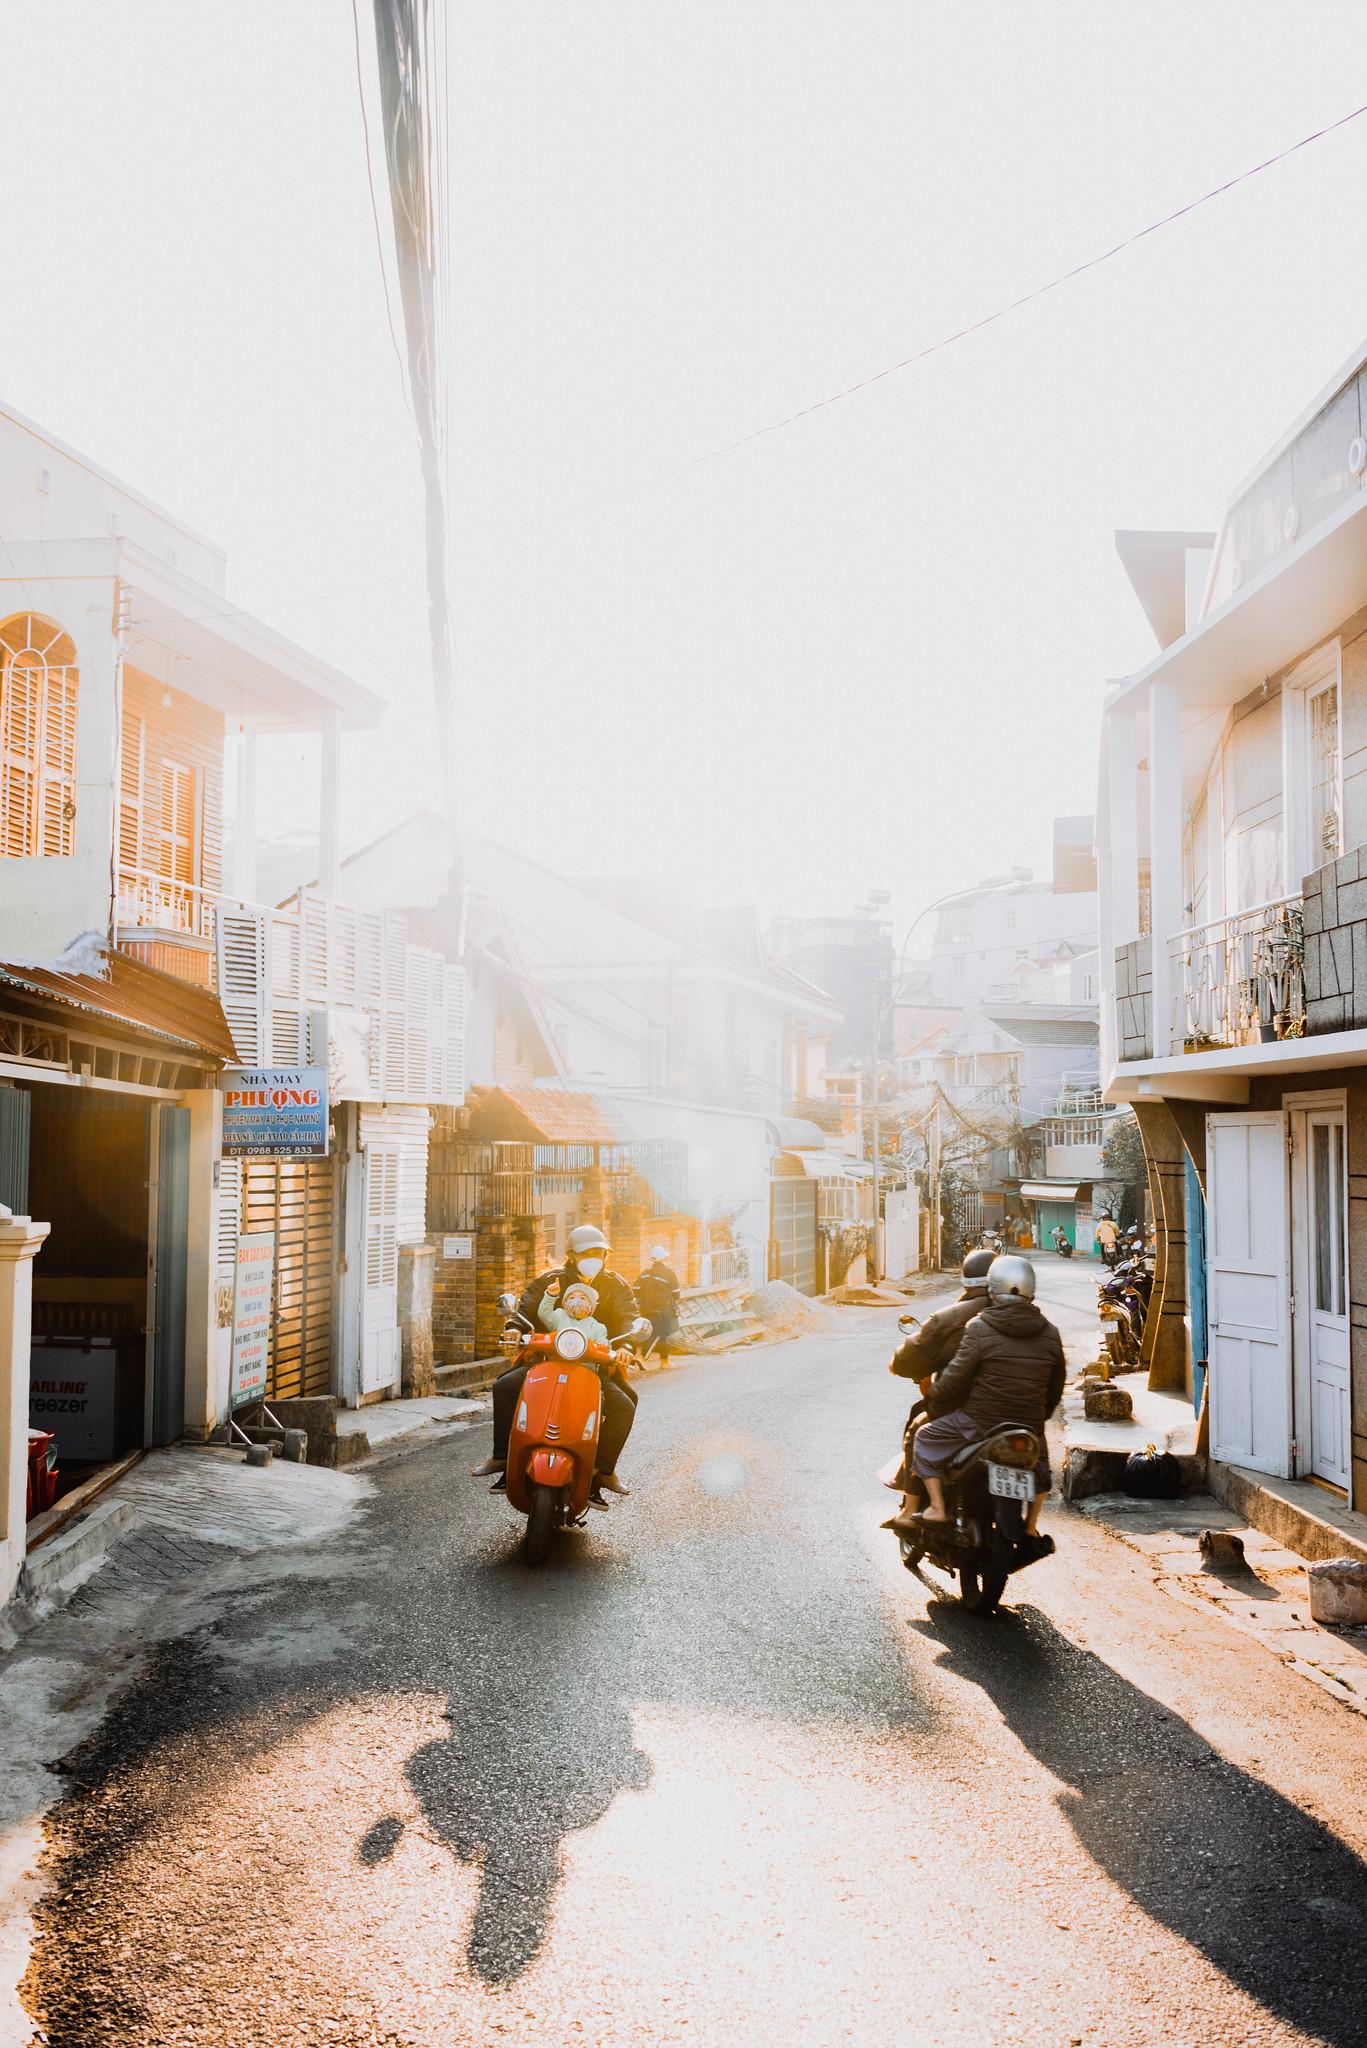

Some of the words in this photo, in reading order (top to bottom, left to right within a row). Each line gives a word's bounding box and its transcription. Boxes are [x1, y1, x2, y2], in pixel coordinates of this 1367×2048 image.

[273, 1075, 303, 1084] MAY
[224, 1087, 319, 1110] PHƯỢNG
[247, 1146, 271, 1155] 0988
[273, 1146, 292, 1154] 525
[294, 1146, 313, 1154] 833
[30, 1380, 86, 1394] ARLING
[29, 1398, 89, 1413] reezer
